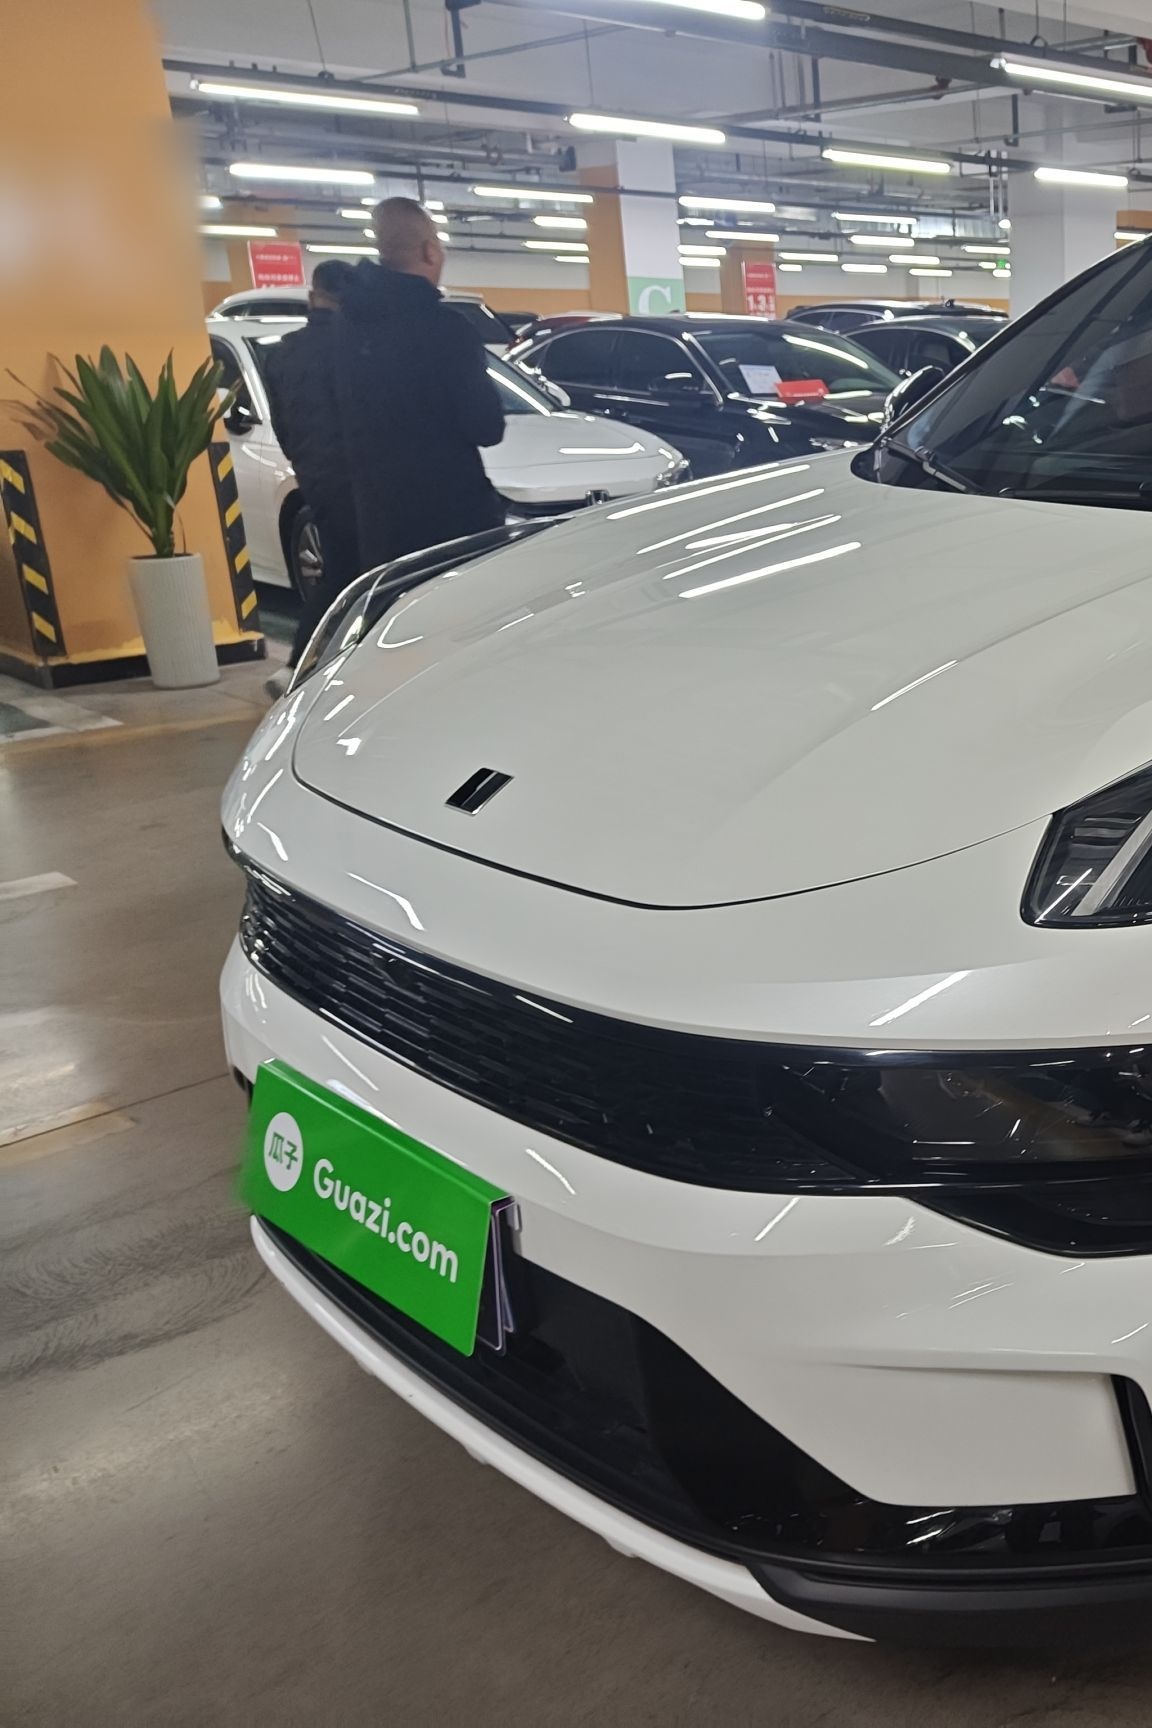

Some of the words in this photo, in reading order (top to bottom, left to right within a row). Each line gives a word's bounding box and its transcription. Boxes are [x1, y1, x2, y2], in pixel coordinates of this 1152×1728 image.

[638, 285, 672, 315] C
[268, 1131, 298, 1171] 瓜子
[313, 1158, 459, 1284] Guazi.com
